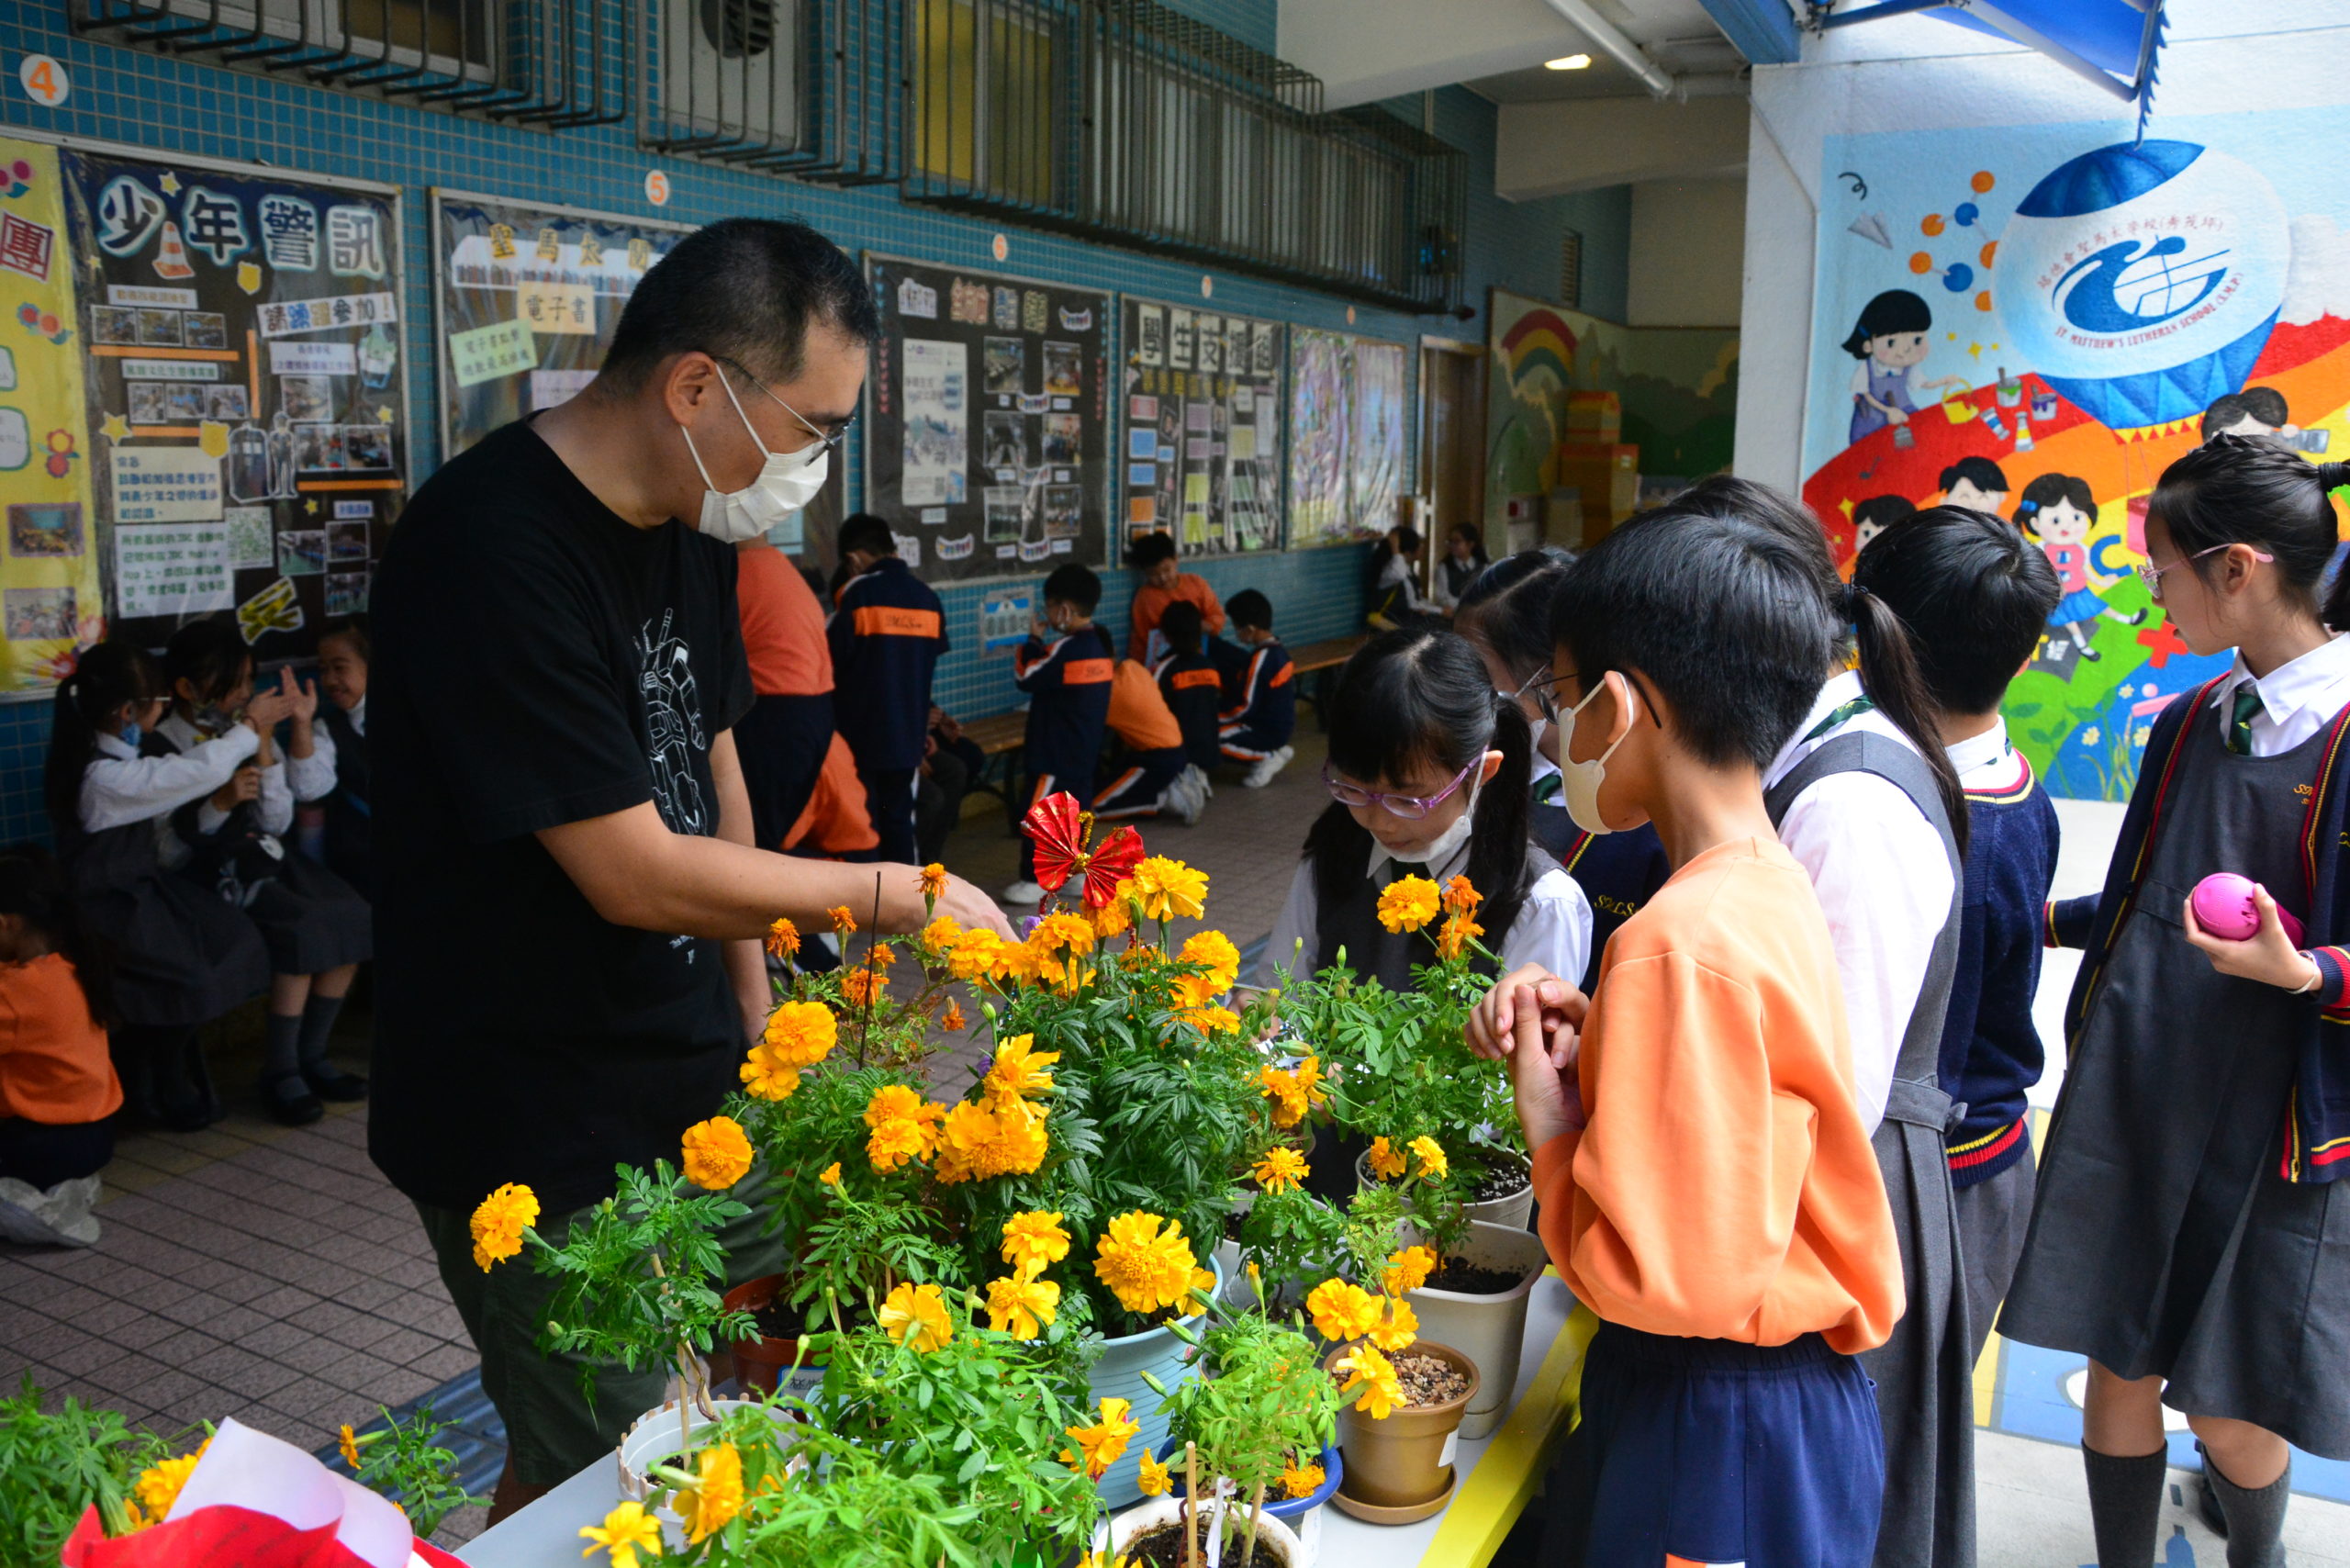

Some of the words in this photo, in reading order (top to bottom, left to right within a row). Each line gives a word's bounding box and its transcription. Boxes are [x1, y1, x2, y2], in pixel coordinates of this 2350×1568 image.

[28, 61, 58, 100] 4
[649, 176, 666, 204] 5
[101, 183, 381, 274] 少年警訊
[526, 294, 587, 324] 電子書
[2127, 324, 2178, 346] LUTHERAN
[2179, 303, 2217, 329] SCHOOL
[2090, 534, 2134, 577] C
